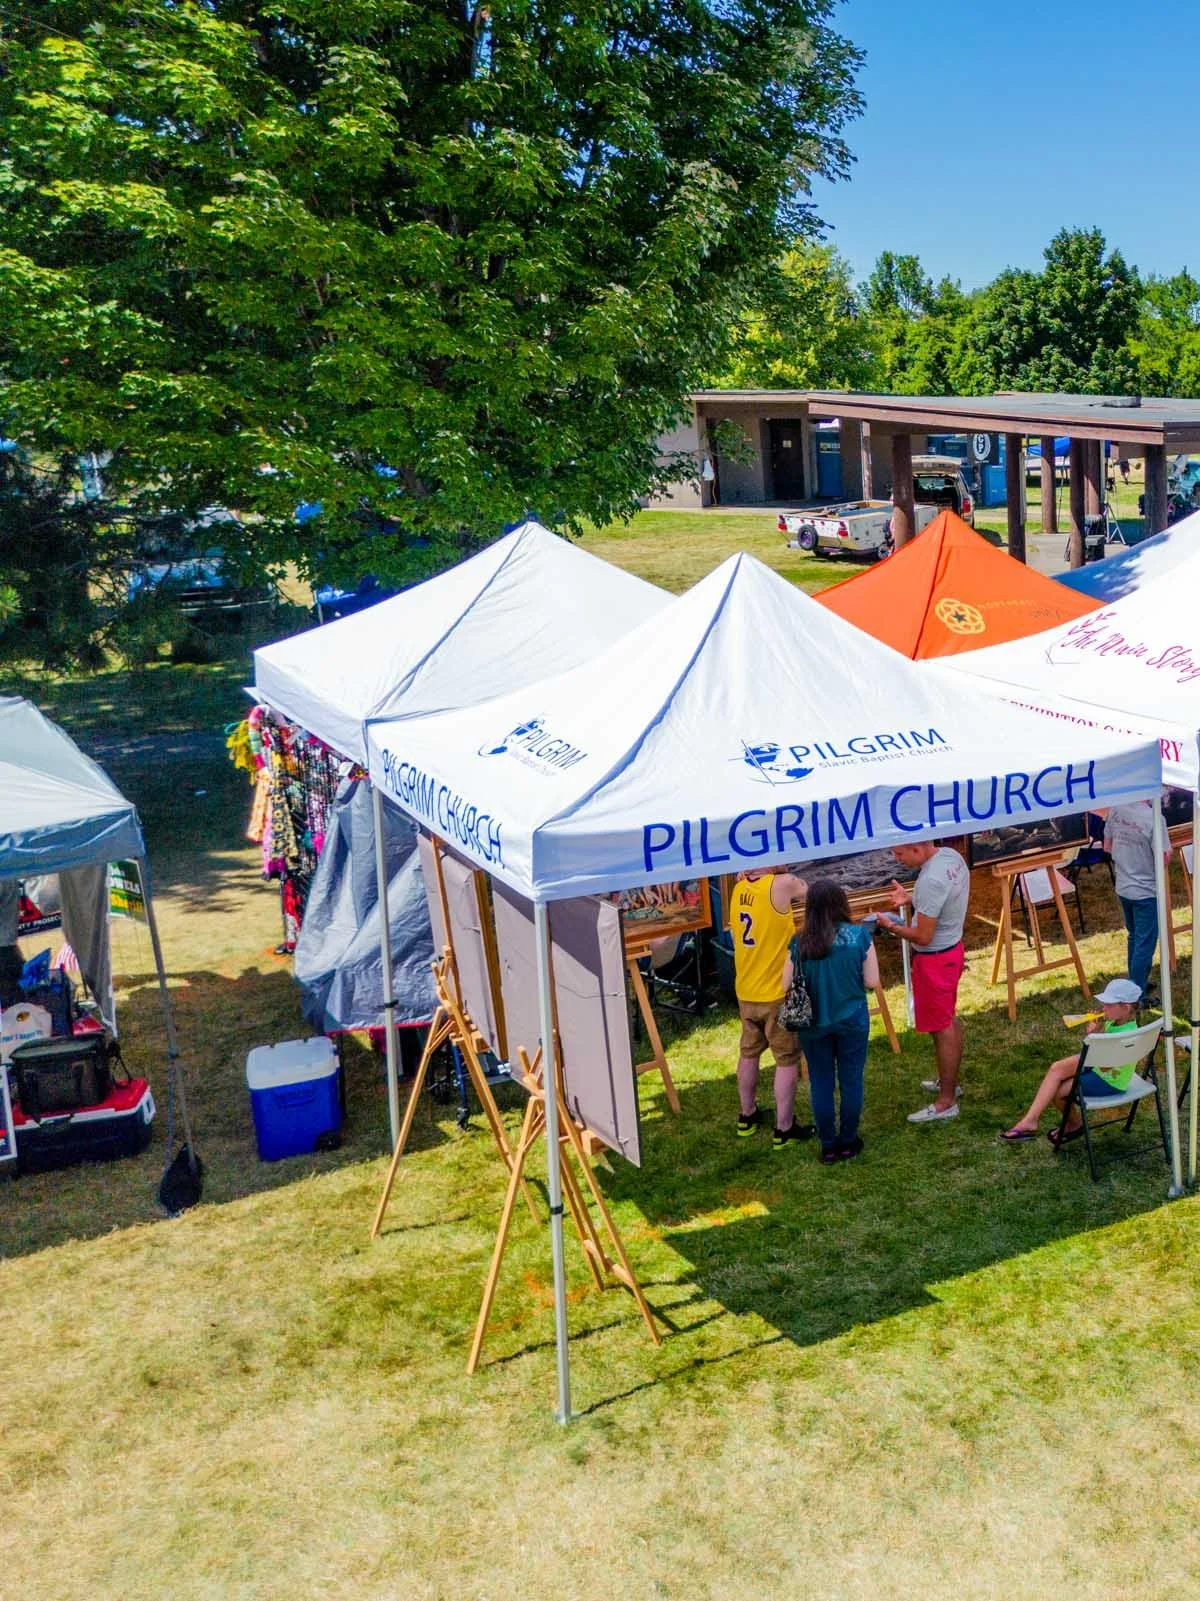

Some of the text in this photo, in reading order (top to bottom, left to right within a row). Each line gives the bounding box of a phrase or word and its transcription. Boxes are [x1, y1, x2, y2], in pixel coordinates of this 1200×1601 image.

[1061, 625, 1109, 649] The
[1094, 633, 1148, 658] Main
[517, 728, 588, 770] PILGRIM
[788, 728, 948, 764] PILGRIM
[818, 745, 953, 769] Slavic Baptist Church
[383, 748, 505, 868] PILGRIM CHURCH
[642, 793, 874, 873] PILGRIM
[889, 760, 1098, 834] CHURCH
[740, 911, 756, 945] 2
